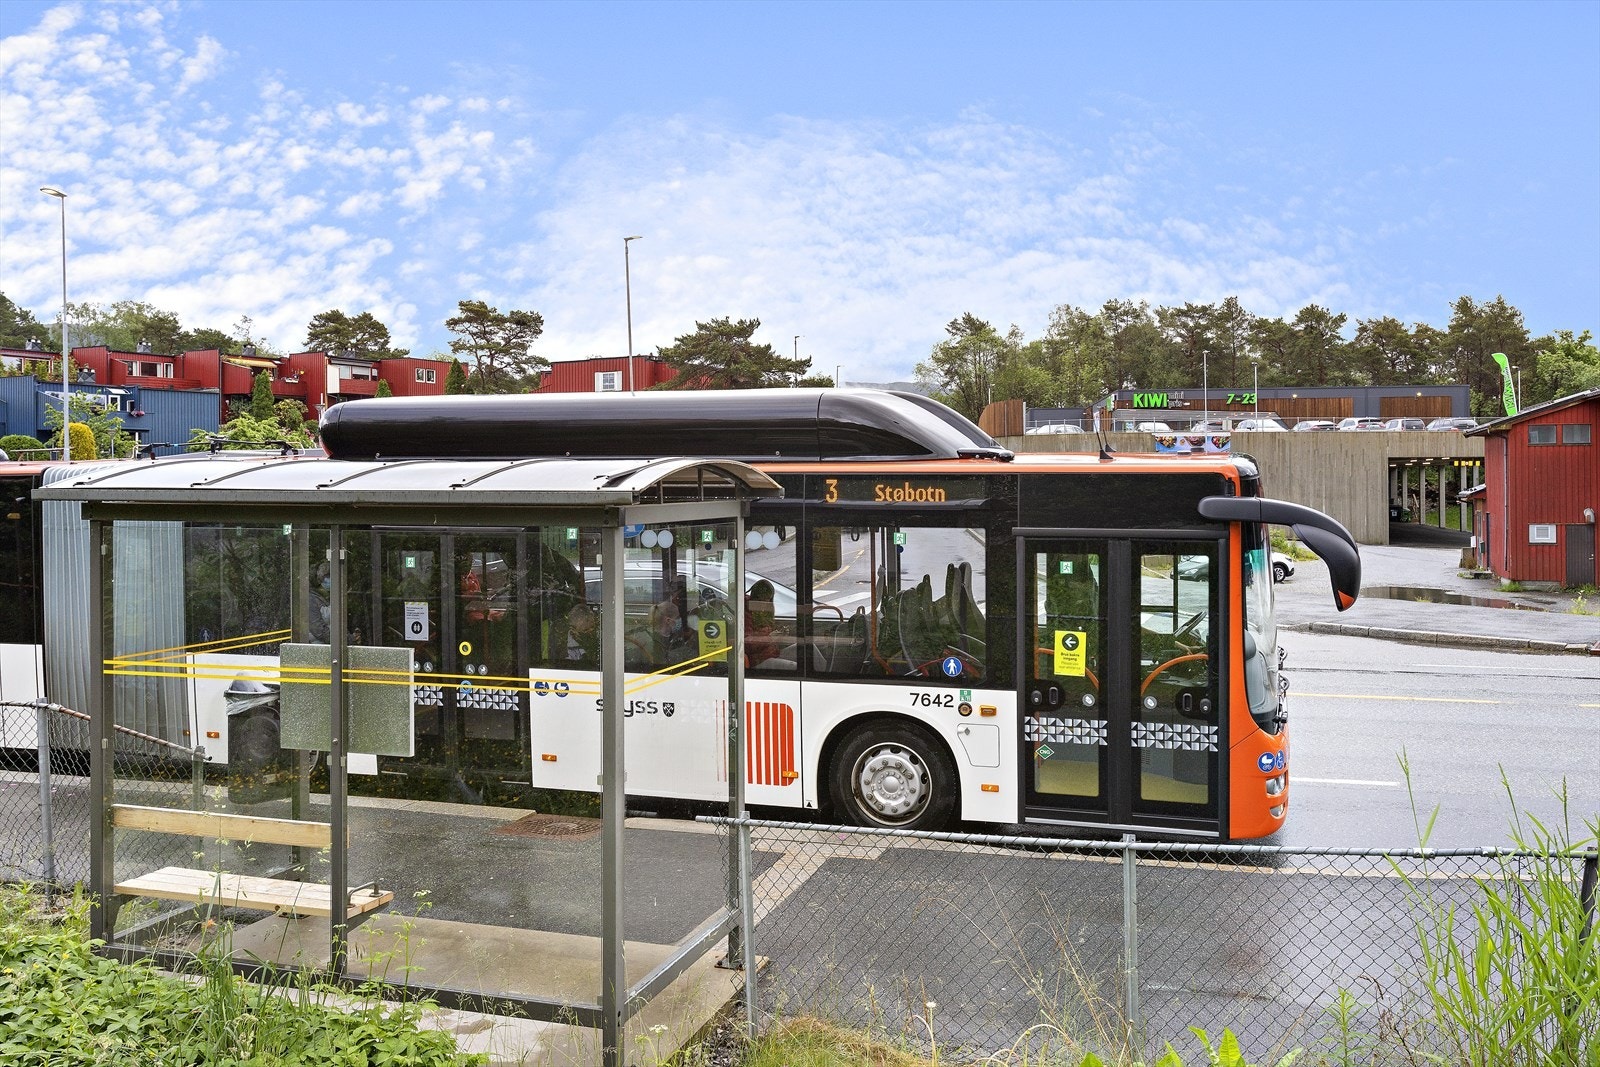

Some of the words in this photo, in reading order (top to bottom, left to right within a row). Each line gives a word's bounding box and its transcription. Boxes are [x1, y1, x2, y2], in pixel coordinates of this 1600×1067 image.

[1133, 393, 1168, 408] KIWI
[825, 479, 838, 503] 3
[875, 482, 946, 502] Støbotn
[909, 692, 954, 708] 7642
